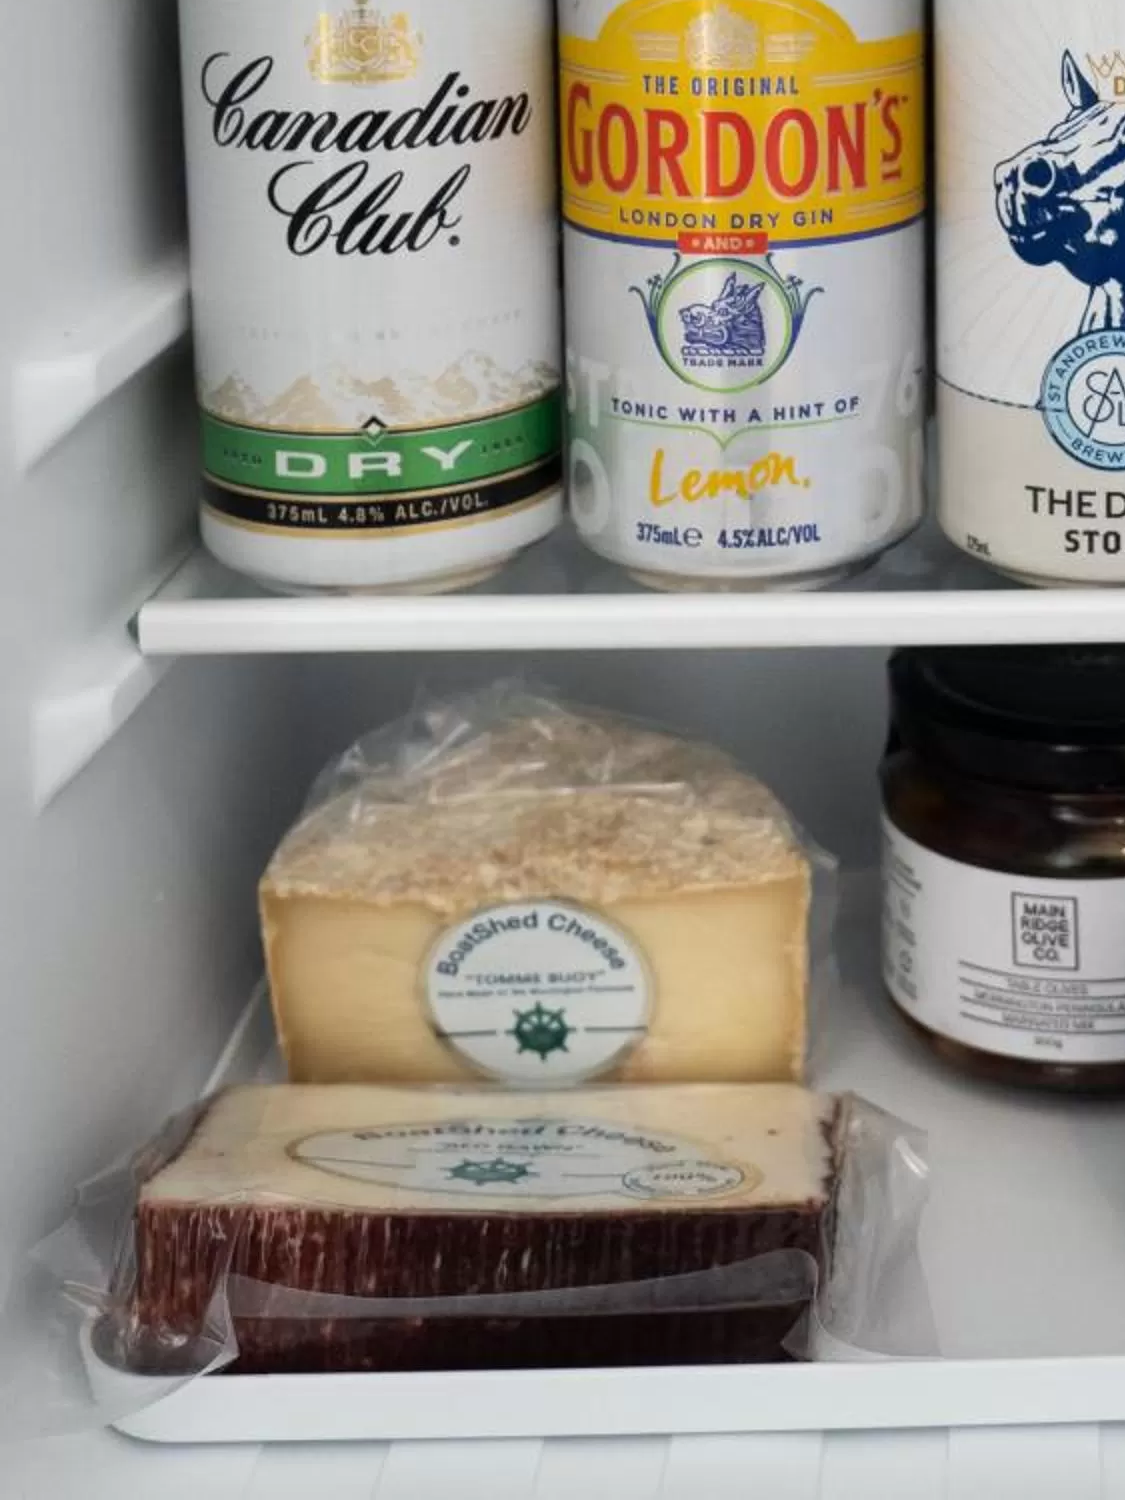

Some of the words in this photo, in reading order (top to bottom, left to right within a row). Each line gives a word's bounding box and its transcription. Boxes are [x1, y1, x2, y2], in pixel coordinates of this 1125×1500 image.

[643, 75, 679, 95] THE
[691, 76, 799, 96] ORIGINAL
[201, 52, 534, 153] Canadian
[567, 80, 908, 198] GORDON'S
[619, 207, 716, 228] LONDON
[730, 211, 781, 229] DRY
[793, 208, 834, 225] GIN
[703, 235, 743, 250] AND
[1048, 383, 1061, 402] ST
[611, 397, 669, 420] TONIC
[678, 407, 737, 423] WITH
[747, 408, 762, 422] A
[773, 403, 825, 418] HINT
[834, 396, 861, 415] OF
[275, 439, 474, 479] DRY
[1025, 485, 1098, 518] THE
[267, 503, 327, 523] 375mL
[337, 505, 385, 523] 4.8%
[1023, 902, 1067, 918] MAIN
[1020, 917, 1070, 933] RIDGE
[436, 910, 538, 977] BoatShed
[547, 913, 626, 971] Cheese
[1021, 932, 1070, 948] OLIVE
